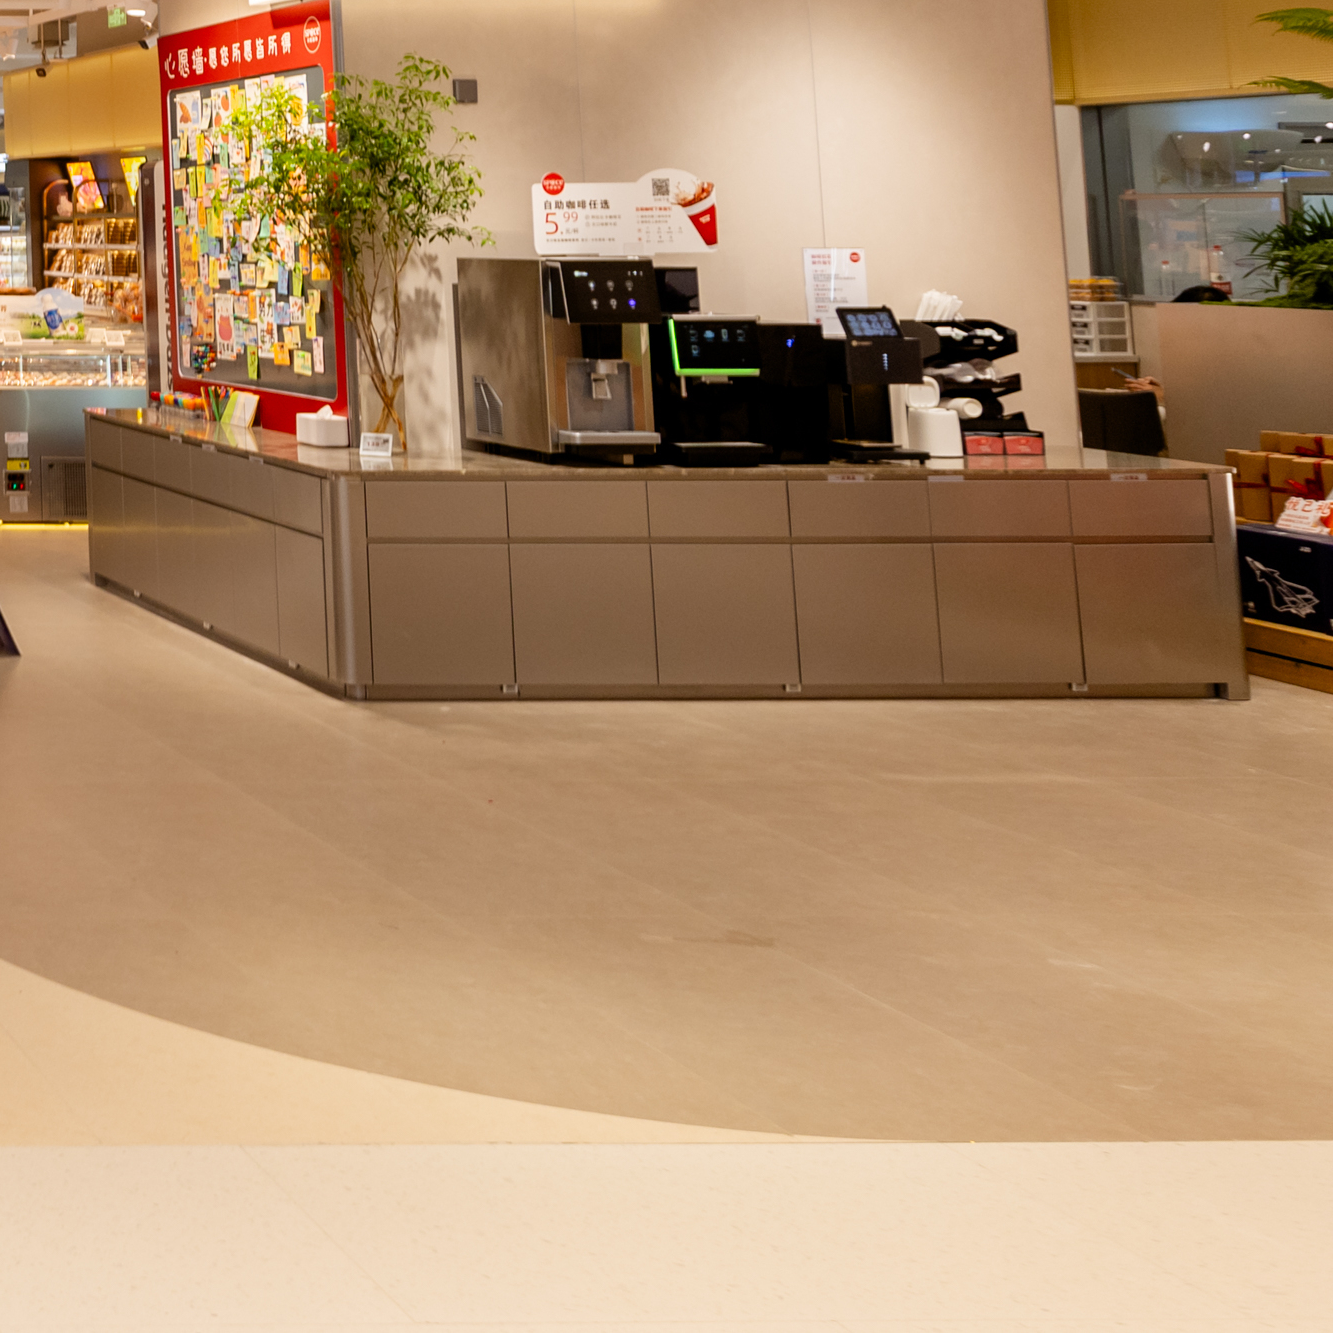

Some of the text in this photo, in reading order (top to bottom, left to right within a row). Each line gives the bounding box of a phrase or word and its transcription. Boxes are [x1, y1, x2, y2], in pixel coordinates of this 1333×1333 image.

[543, 199, 611, 211] 自助咖啡任选
